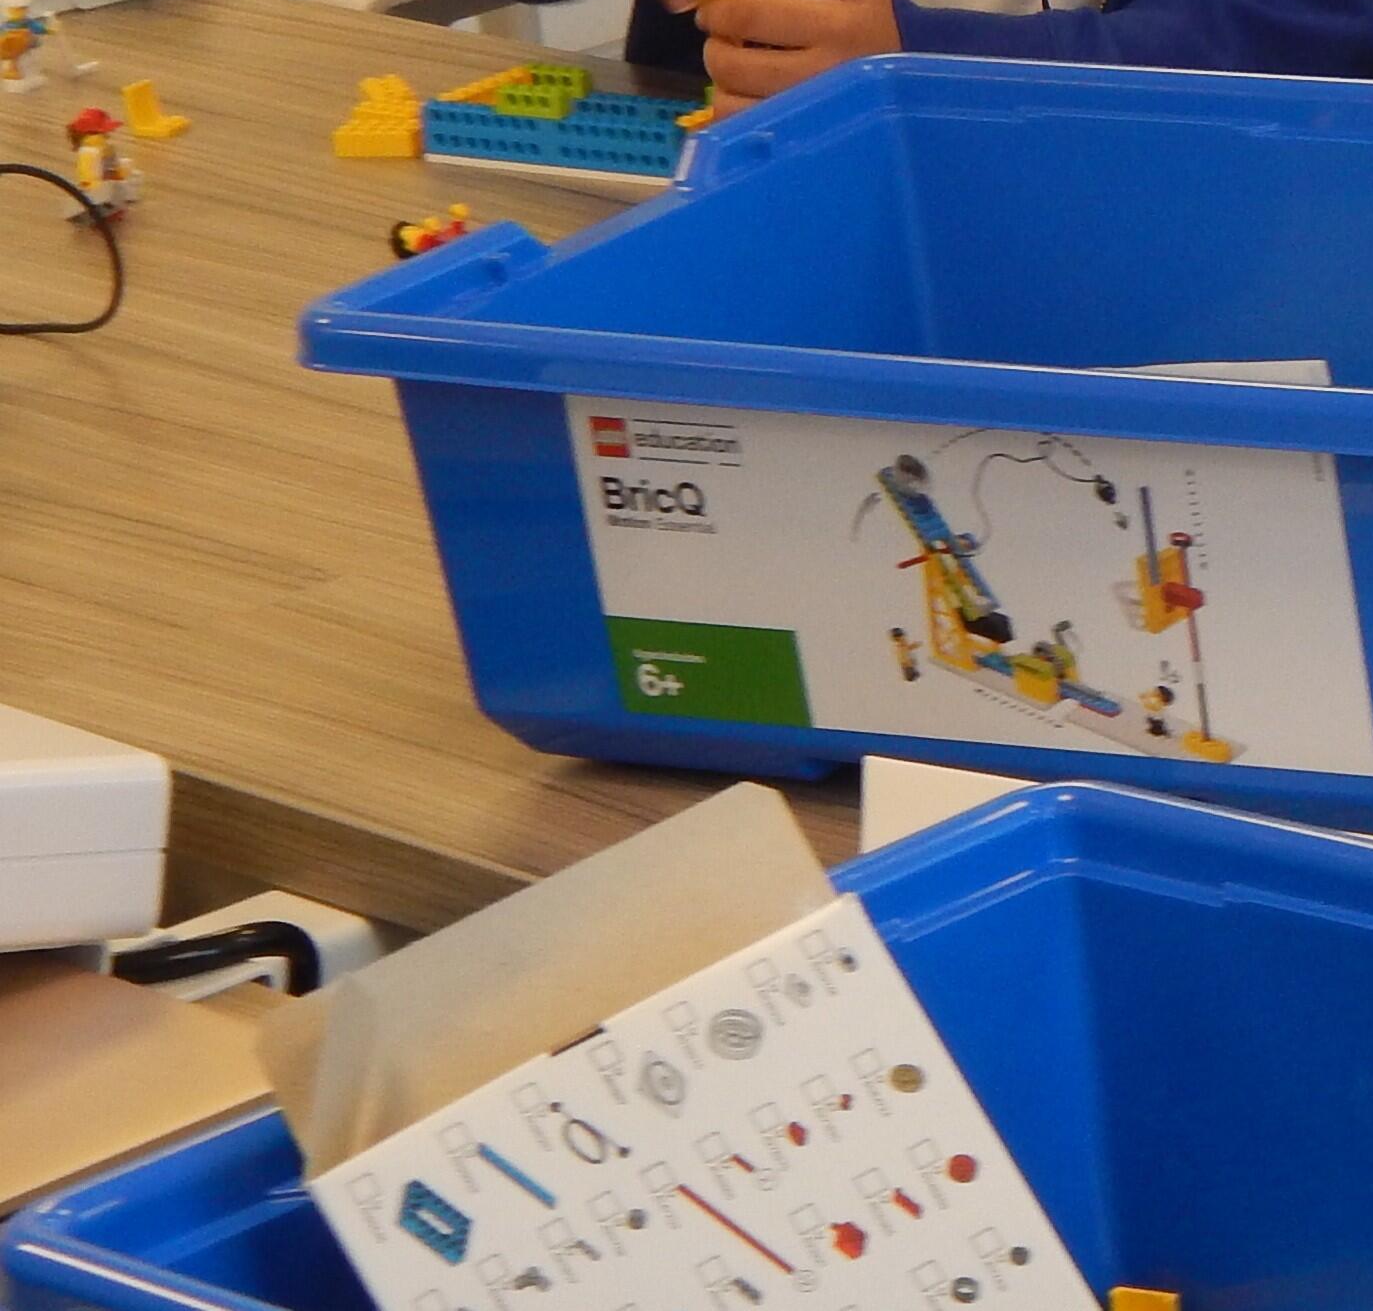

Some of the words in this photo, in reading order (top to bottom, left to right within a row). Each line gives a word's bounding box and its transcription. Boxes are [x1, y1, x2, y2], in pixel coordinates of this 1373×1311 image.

[634, 429, 743, 455] education
[600, 475, 706, 517] BricQ
[637, 663, 685, 697] 6+
